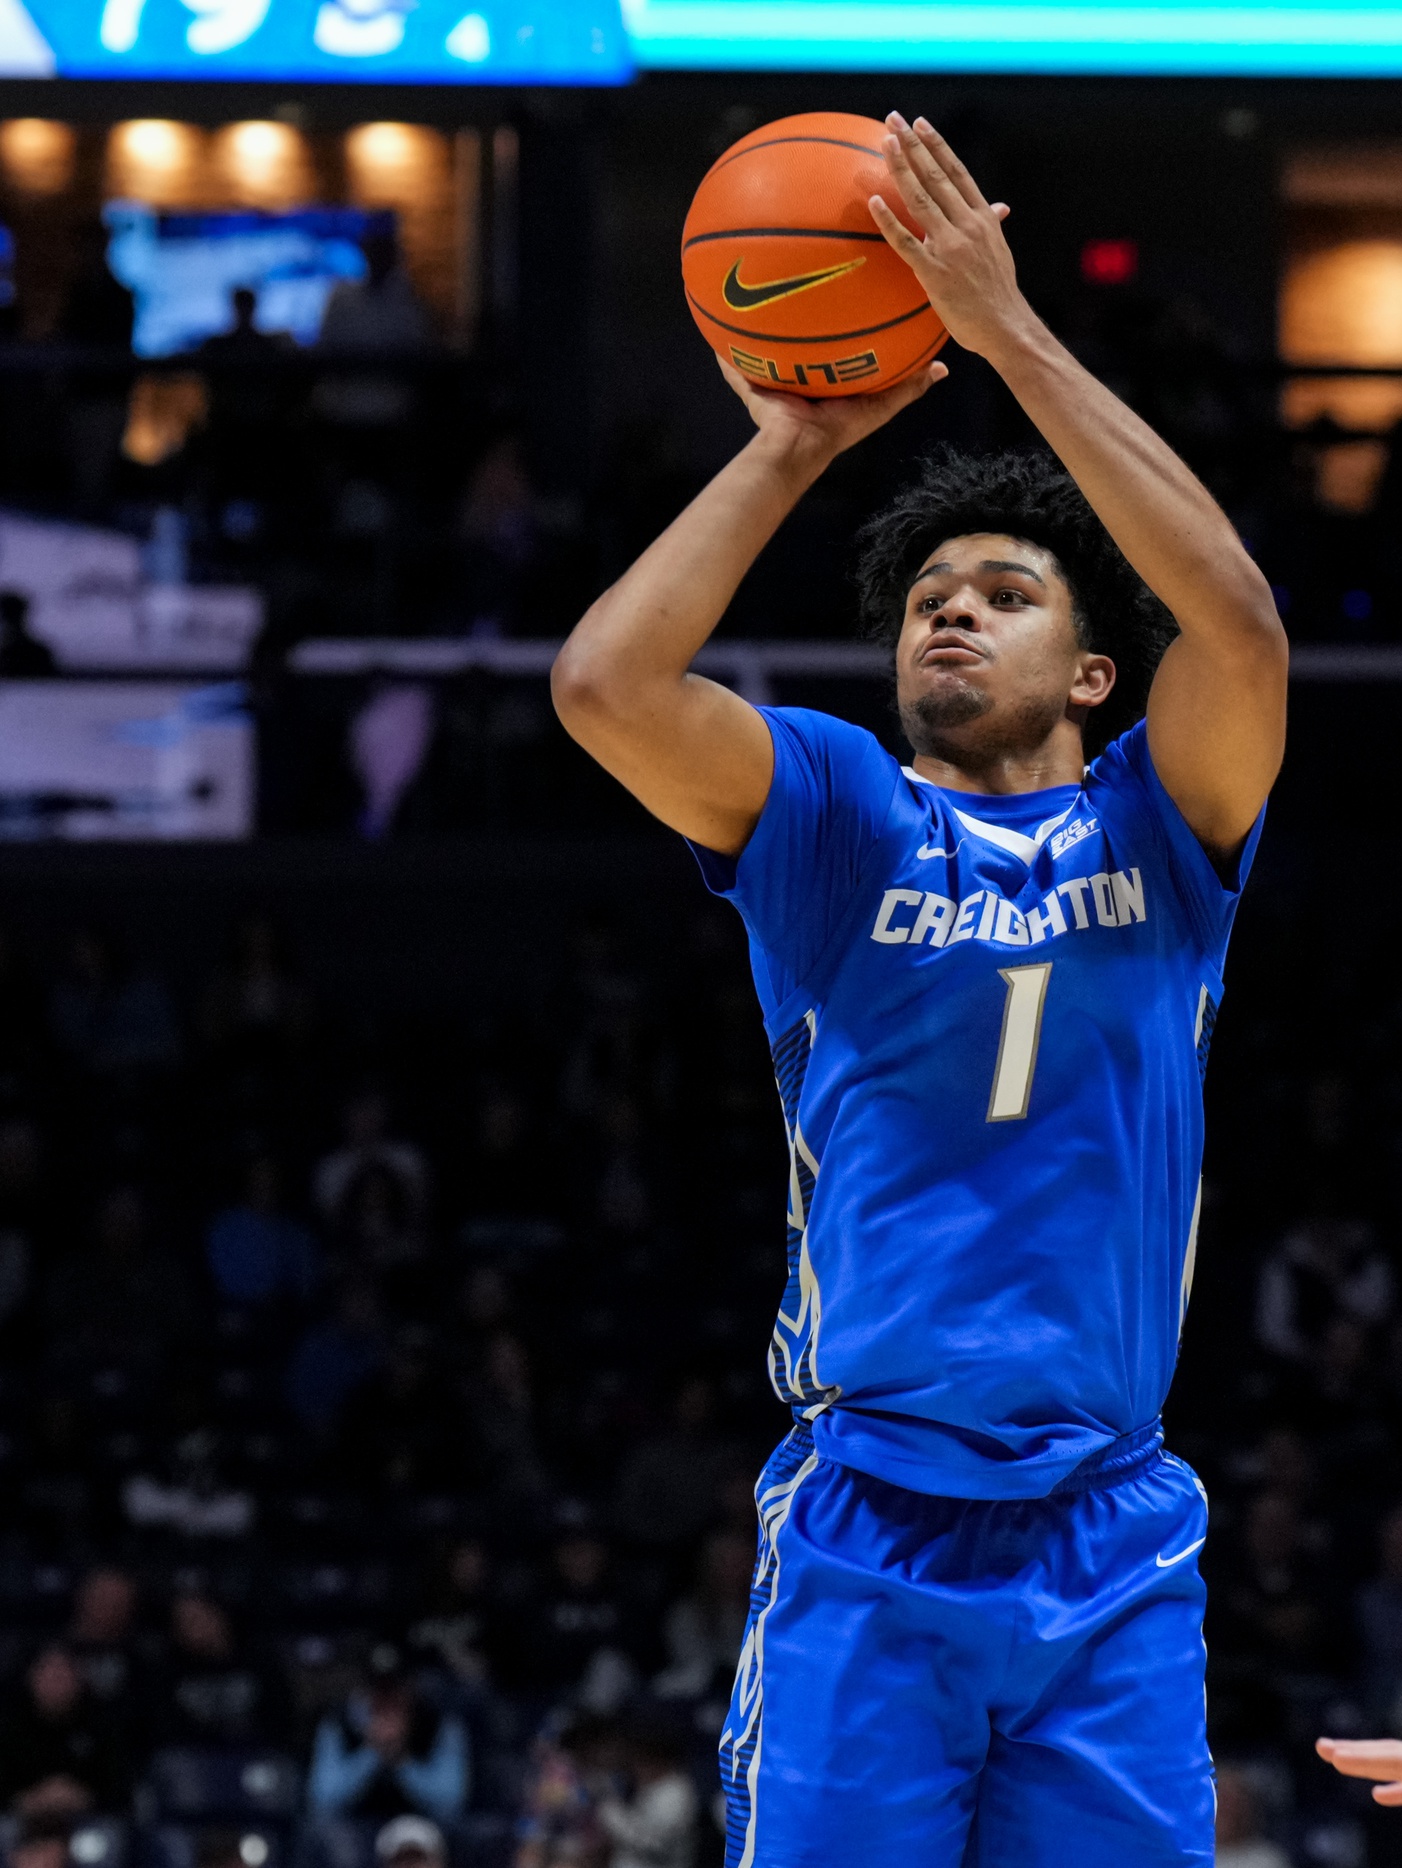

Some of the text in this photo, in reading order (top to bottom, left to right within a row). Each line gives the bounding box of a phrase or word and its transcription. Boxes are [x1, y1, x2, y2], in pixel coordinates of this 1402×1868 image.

[728, 344, 880, 386] ELITE
[1050, 818, 1083, 849] BIG
[1051, 818, 1098, 856] EAST
[870, 867, 1147, 949] CREIGHTON
[985, 962, 1053, 1123] 1
